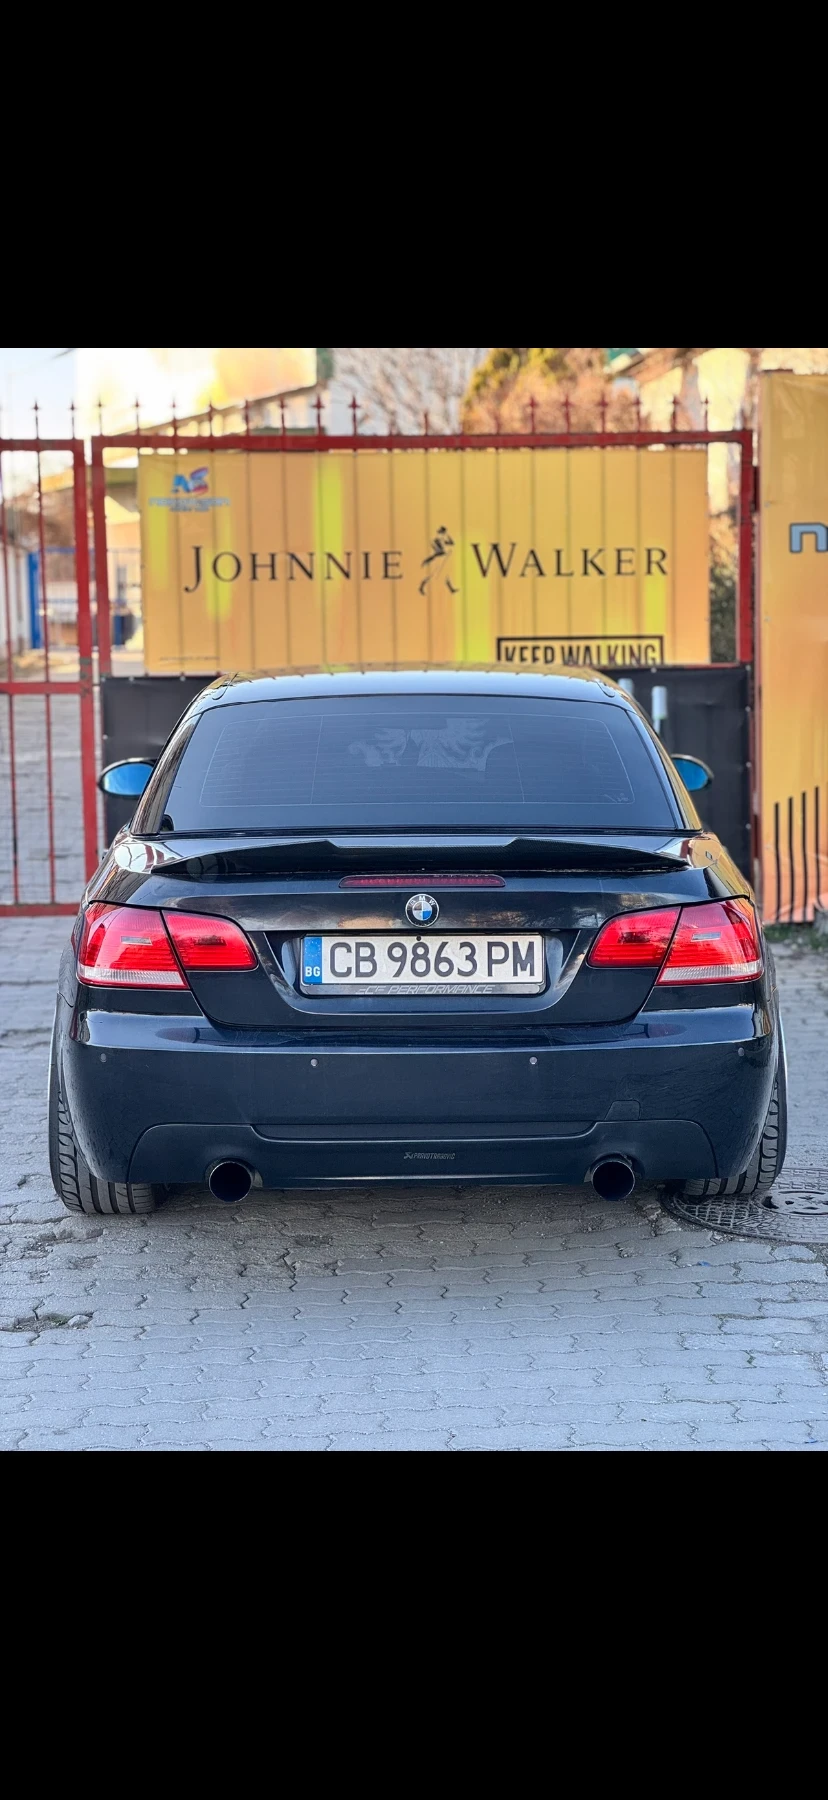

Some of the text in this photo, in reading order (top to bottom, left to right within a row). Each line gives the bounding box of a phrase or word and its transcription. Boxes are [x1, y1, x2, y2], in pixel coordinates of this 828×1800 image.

[184, 542, 668, 593] JOHNNIE WALKER
[561, 644, 657, 667] WALKING
[329, 941, 535, 978] CB 9863 PM
[305, 966, 321, 977] BG
[387, 984, 496, 995] PERFORMANCE
